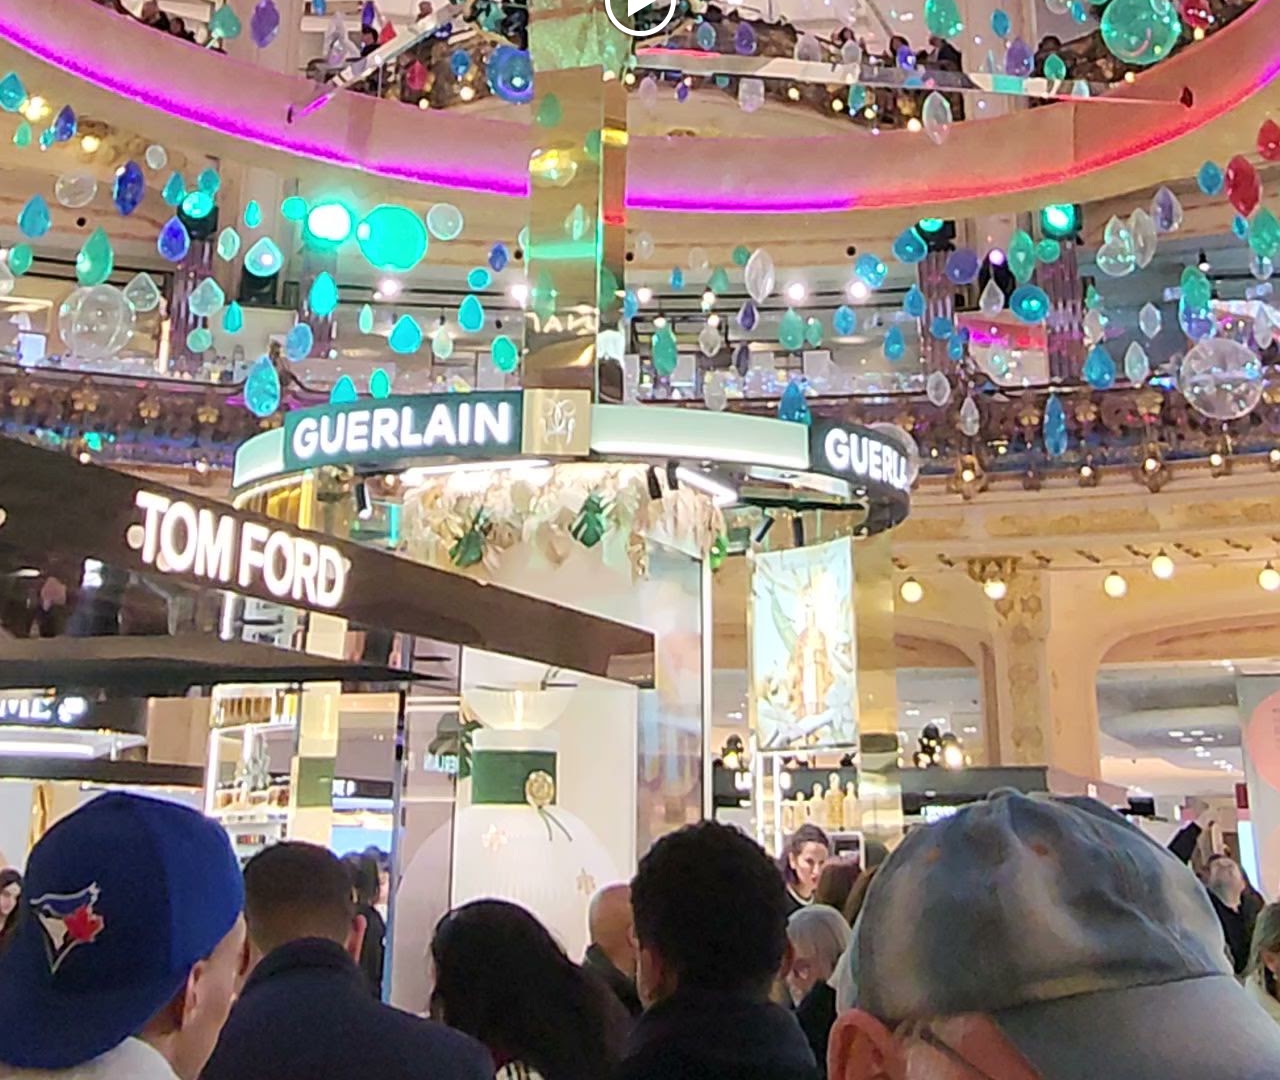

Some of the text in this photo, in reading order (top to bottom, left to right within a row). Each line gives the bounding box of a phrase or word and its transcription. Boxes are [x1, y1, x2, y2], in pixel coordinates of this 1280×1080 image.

[292, 401, 513, 459] GUERLAIN
[135, 490, 347, 609] TOM FORD
